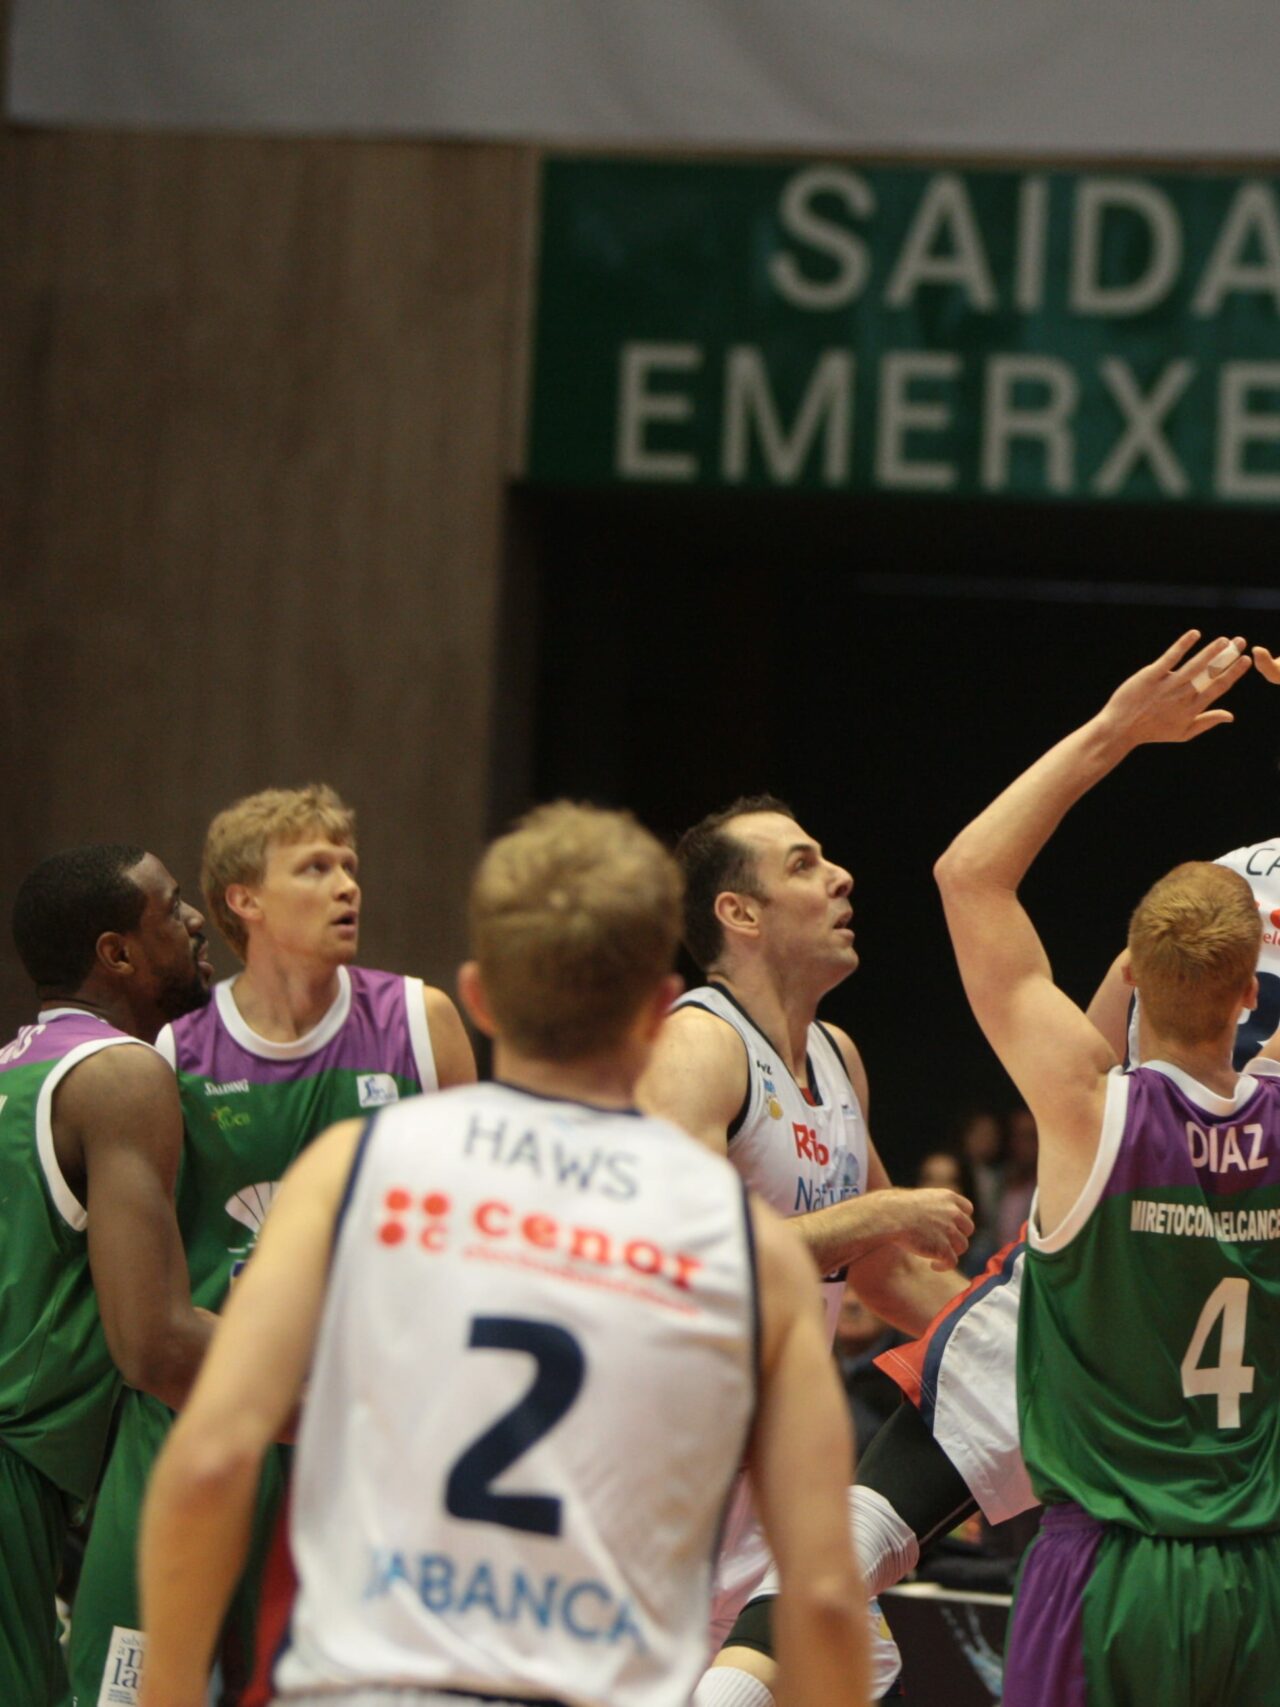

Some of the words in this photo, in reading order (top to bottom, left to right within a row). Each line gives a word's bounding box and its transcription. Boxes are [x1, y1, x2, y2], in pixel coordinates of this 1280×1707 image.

[461, 1109, 642, 1202] HAWS
[1185, 1120, 1269, 1174] DIAZ
[472, 1199, 704, 1293] cenor
[1180, 1277, 1255, 1429] 4
[443, 1316, 587, 1538] 2
[367, 1550, 652, 1650] ABANCA
